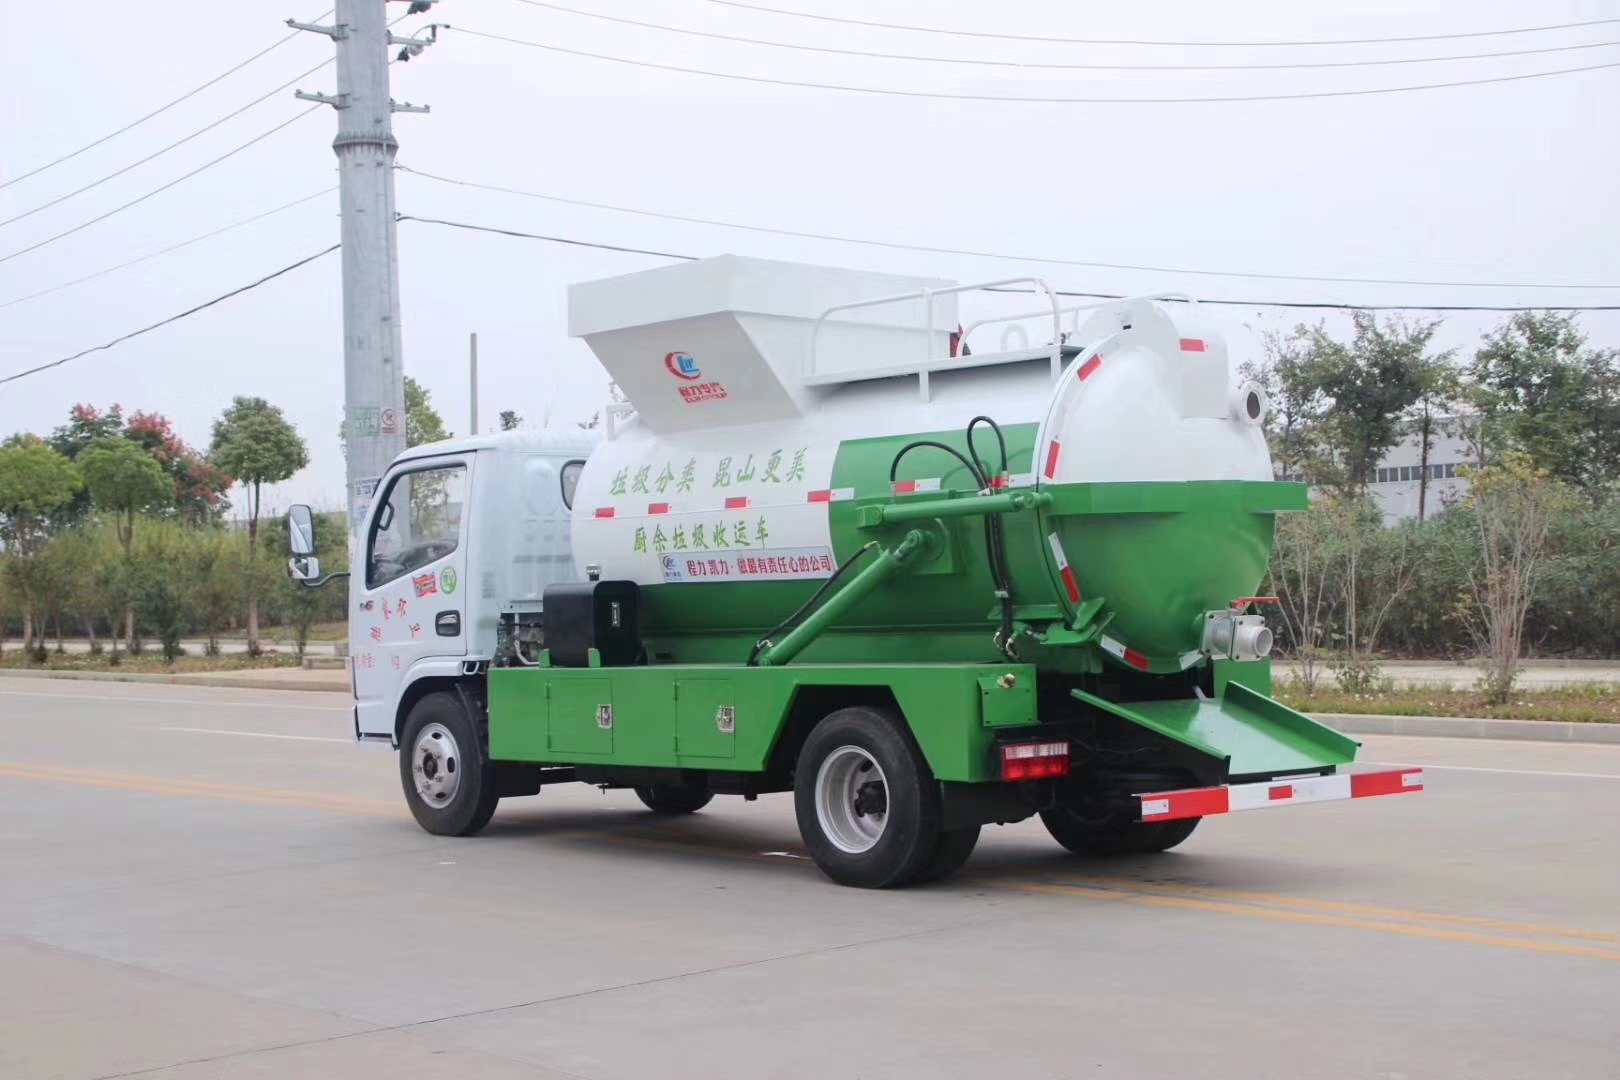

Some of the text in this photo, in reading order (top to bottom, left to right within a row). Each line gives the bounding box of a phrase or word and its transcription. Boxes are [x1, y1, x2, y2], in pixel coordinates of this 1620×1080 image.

[609, 447, 808, 495] 垃圾分类 昆山更美
[633, 515, 769, 553] 厨余垃圾收运车
